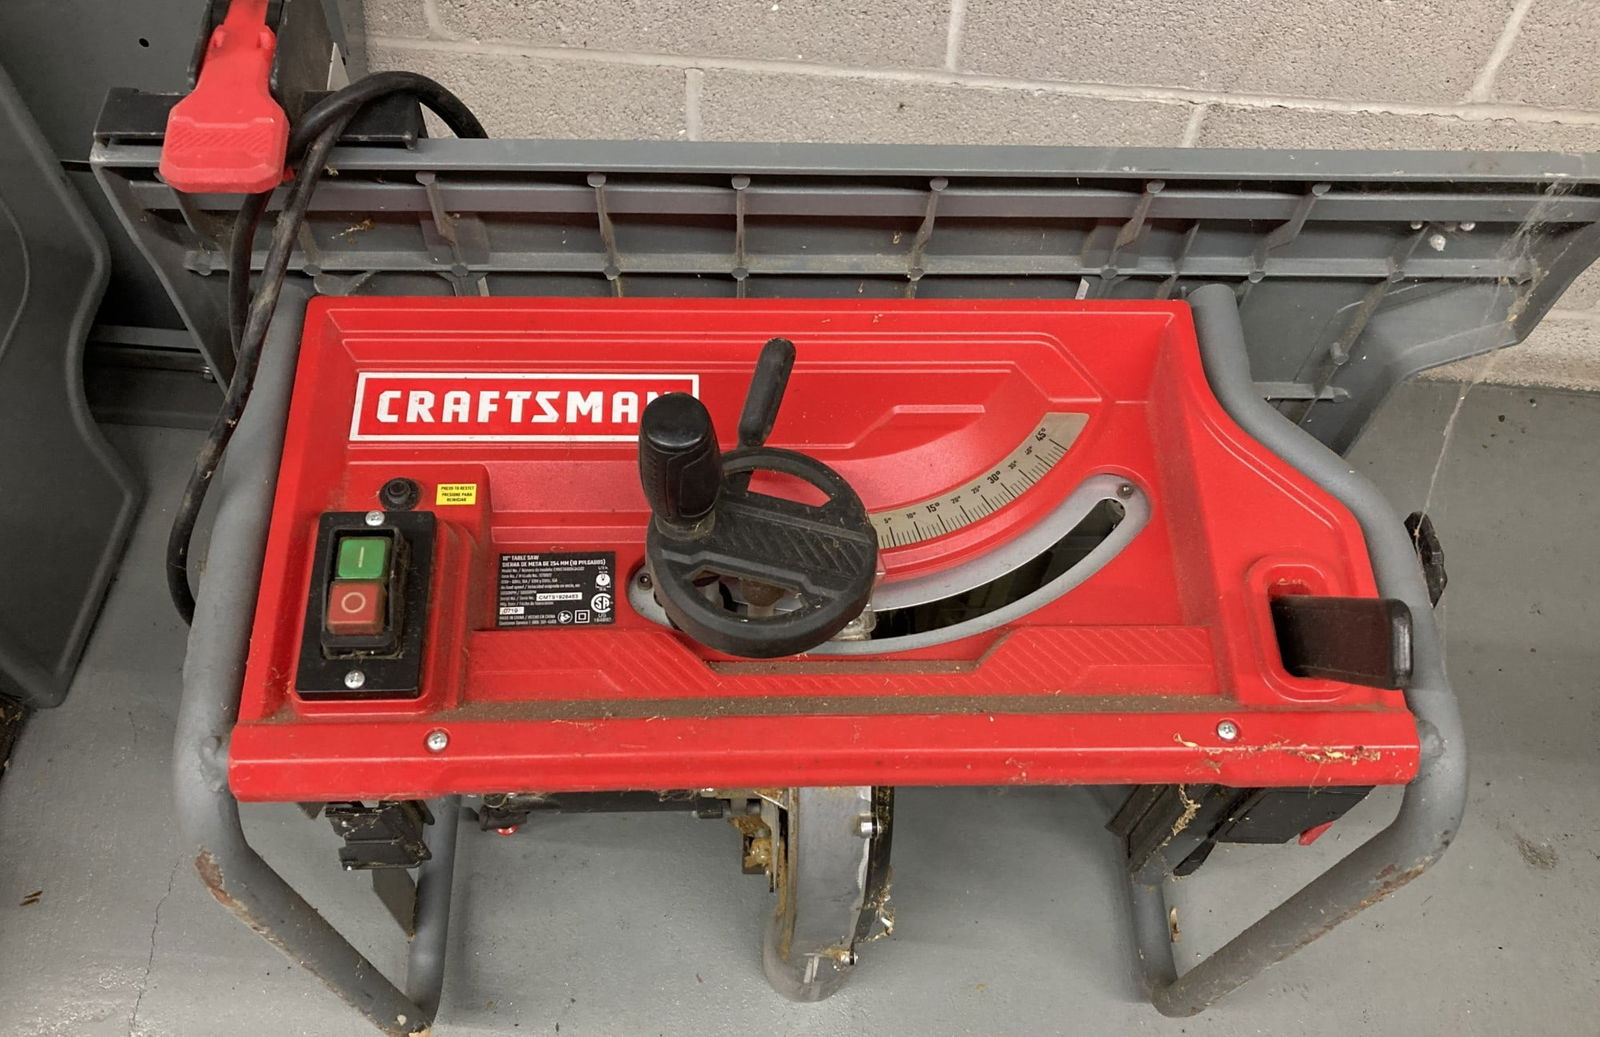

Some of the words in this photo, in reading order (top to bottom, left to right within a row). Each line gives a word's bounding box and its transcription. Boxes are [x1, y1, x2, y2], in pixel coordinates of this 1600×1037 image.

[376, 390, 670, 423] CRAFTSMA
[906, 512, 916, 520] 10°
[926, 502, 940, 513] 15°
[950, 495, 962, 504] 20°
[971, 485, 982, 495] 25°
[987, 470, 1001, 484] 30°
[1035, 428, 1047, 442] 45°
